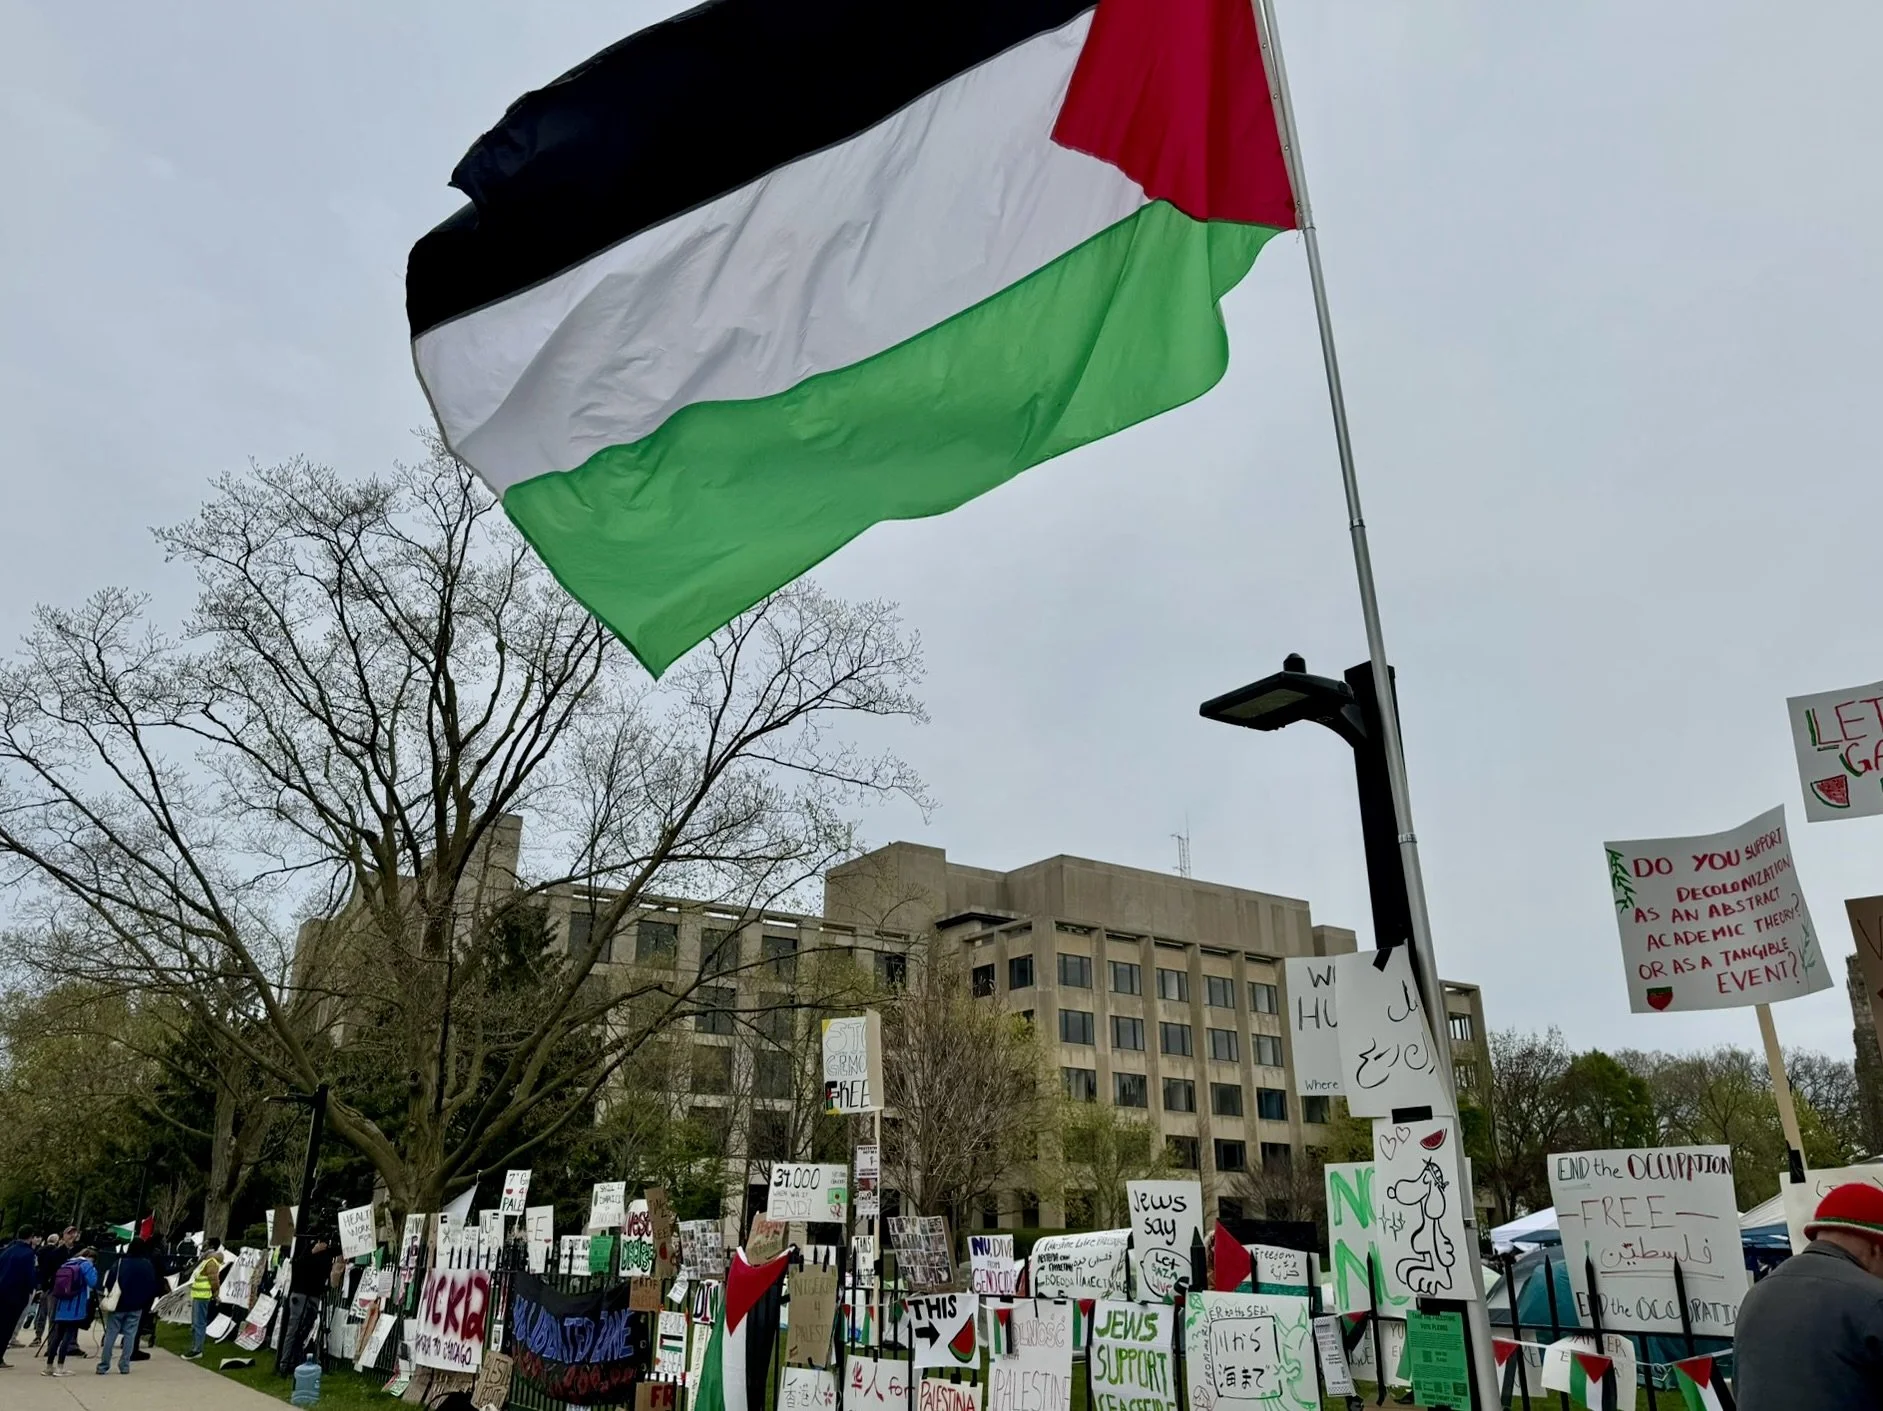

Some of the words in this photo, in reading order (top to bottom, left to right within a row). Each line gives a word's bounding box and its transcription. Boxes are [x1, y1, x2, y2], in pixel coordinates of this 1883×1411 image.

[1633, 857, 1673, 878] DO
[1692, 849, 1740, 872] YOU
[1745, 827, 1782, 860] SUPPORT
[1677, 855, 1791, 902] DECOLONIZATION
[1635, 906, 1660, 923] AS
[1672, 907, 1699, 923] AN
[1709, 887, 1780, 918] ABSTRACT
[1647, 923, 1745, 952] ACADEMIC
[1639, 960, 1668, 980] OR
[1673, 957, 1696, 974] AS
[1701, 955, 1713, 970] A
[1720, 937, 1789, 967] TANGIBLE
[1717, 951, 1801, 994] EVENT?
[1305, 1079, 1339, 1091] Where
[774, 1167, 820, 1190] 34,000
[1558, 1156, 1590, 1181] END
[1594, 1157, 1623, 1179] the
[1627, 1152, 1732, 1181] OCCUPATION
[1134, 1190, 1187, 1213] Jews
[1144, 1217, 1176, 1246] say
[908, 1295, 957, 1321] THIS
[1576, 1292, 1608, 1319] ED
[1611, 1299, 1632, 1318] the
[1012, 1314, 1065, 1348] OLNOŚĆ
[1095, 1309, 1158, 1342] JEWS
[1094, 1345, 1168, 1396] SUPPORT
[920, 1381, 975, 1411] PALESTINA
